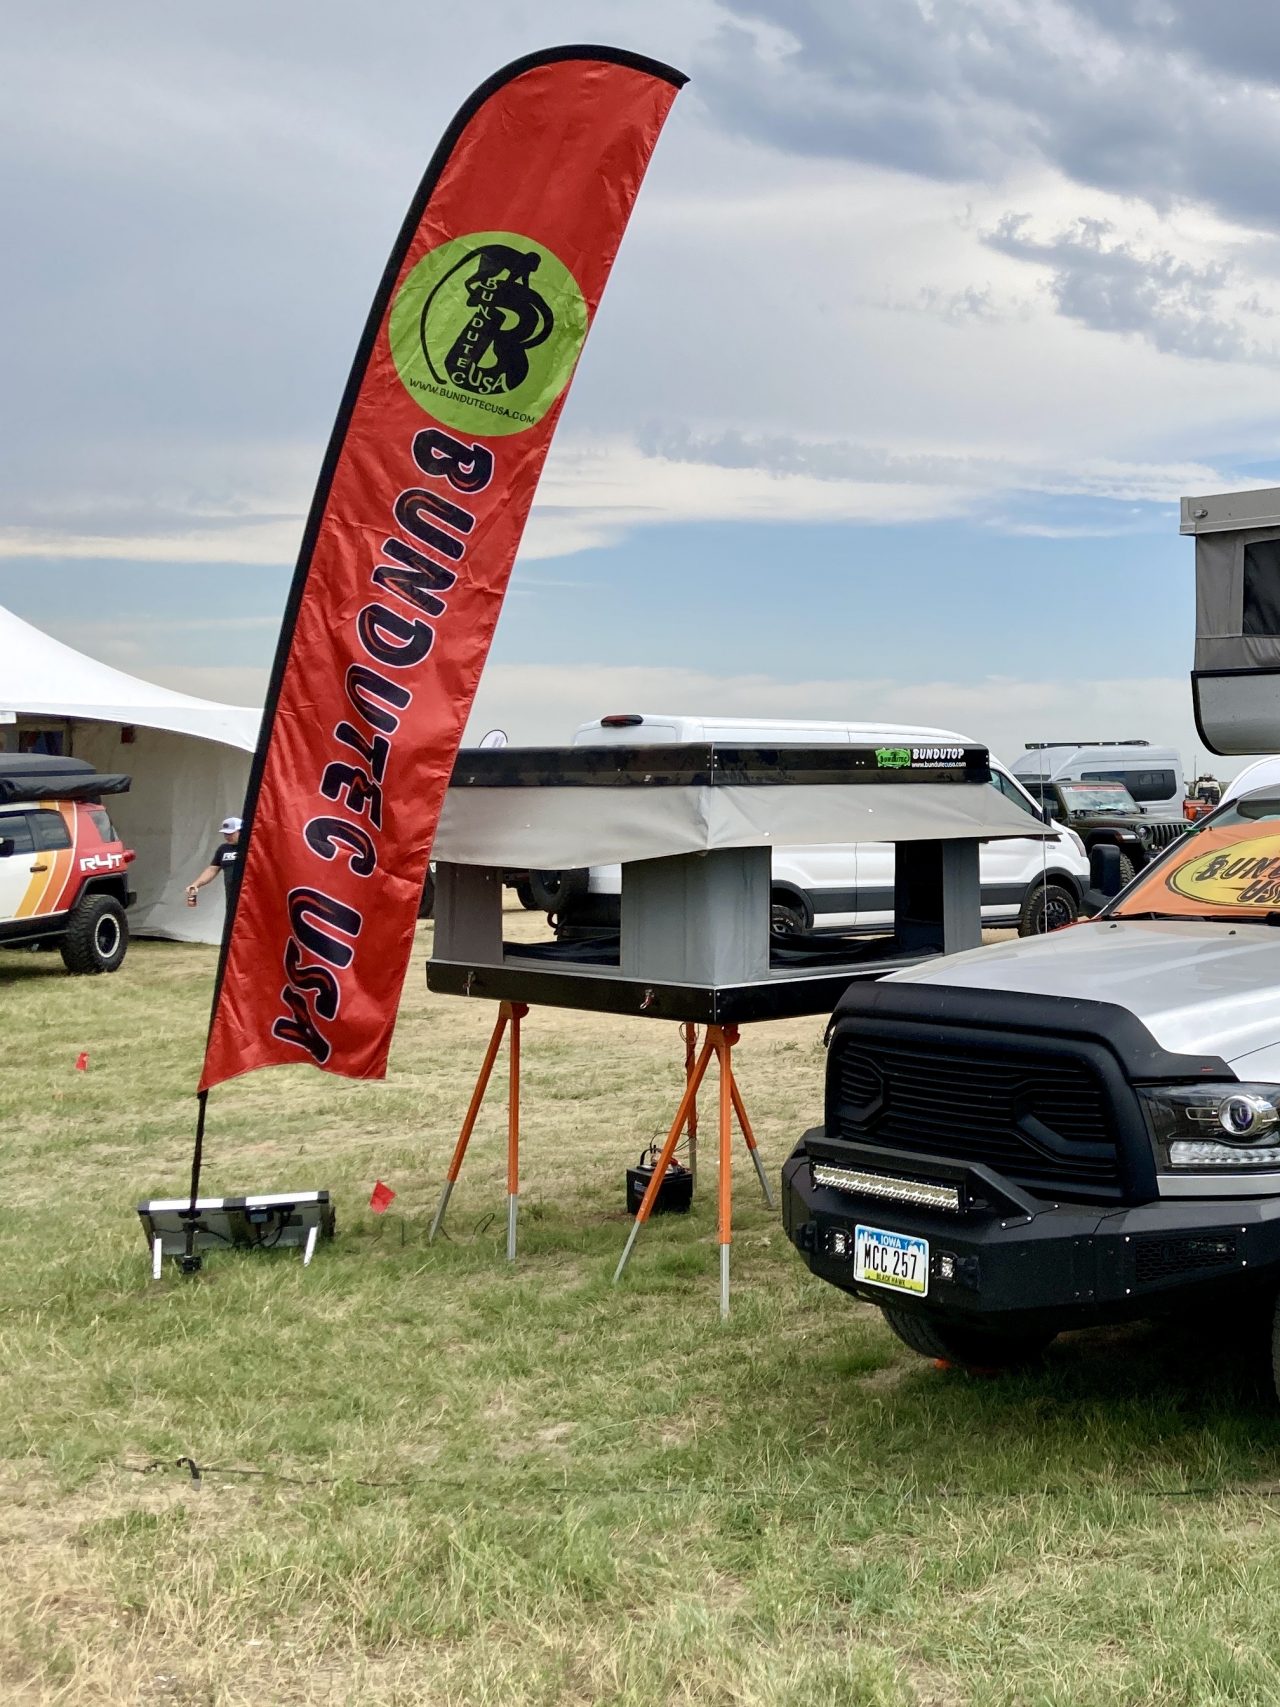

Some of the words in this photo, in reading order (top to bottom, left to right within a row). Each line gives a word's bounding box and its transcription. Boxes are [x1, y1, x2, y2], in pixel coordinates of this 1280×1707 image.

[451, 278, 498, 385] BUNDUTEC
[468, 361, 510, 394] USA
[409, 378, 536, 425] WWW.BUNDUTECUSA.COM
[303, 428, 495, 878] BUNDUTEC
[912, 748, 964, 760] BUNDUTOP
[79, 852, 123, 872] R4T
[272, 887, 363, 1065] USA
[881, 1235, 901, 1249] IOWA
[864, 1243, 887, 1273] MCC
[893, 1251, 917, 1279] 257
